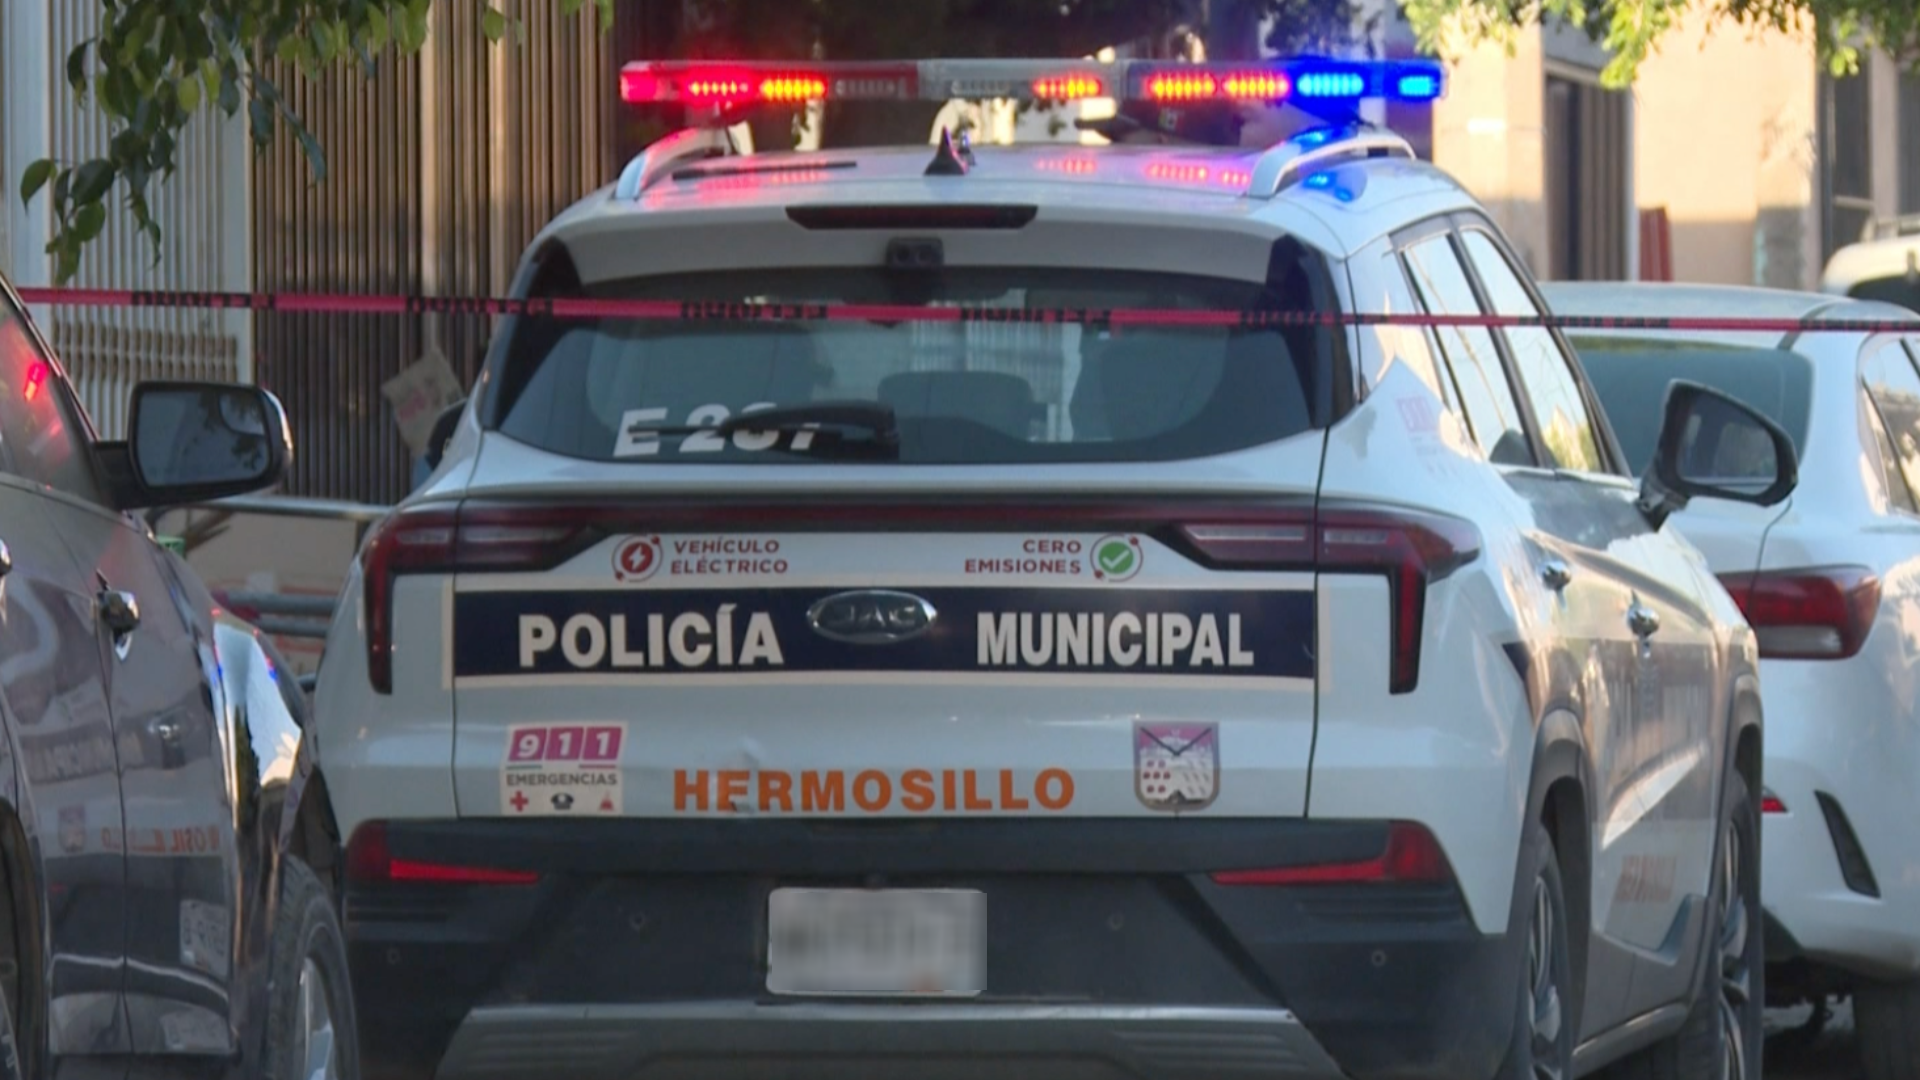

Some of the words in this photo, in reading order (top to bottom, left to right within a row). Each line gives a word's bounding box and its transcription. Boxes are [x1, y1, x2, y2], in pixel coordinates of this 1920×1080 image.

[613, 407, 668, 457] E
[674, 536, 780, 555] VEHÍCULO
[1023, 539, 1082, 554] CERO
[671, 556, 789, 575] ELÉCTRICO
[964, 558, 1082, 574] EMISIONES
[518, 603, 785, 668] POLICÍA
[977, 611, 1255, 667] MUNICIPAL
[518, 731, 610, 759] 911
[506, 772, 618, 788] EMERGENCIAS
[673, 768, 1076, 812] HERMOSILLO
